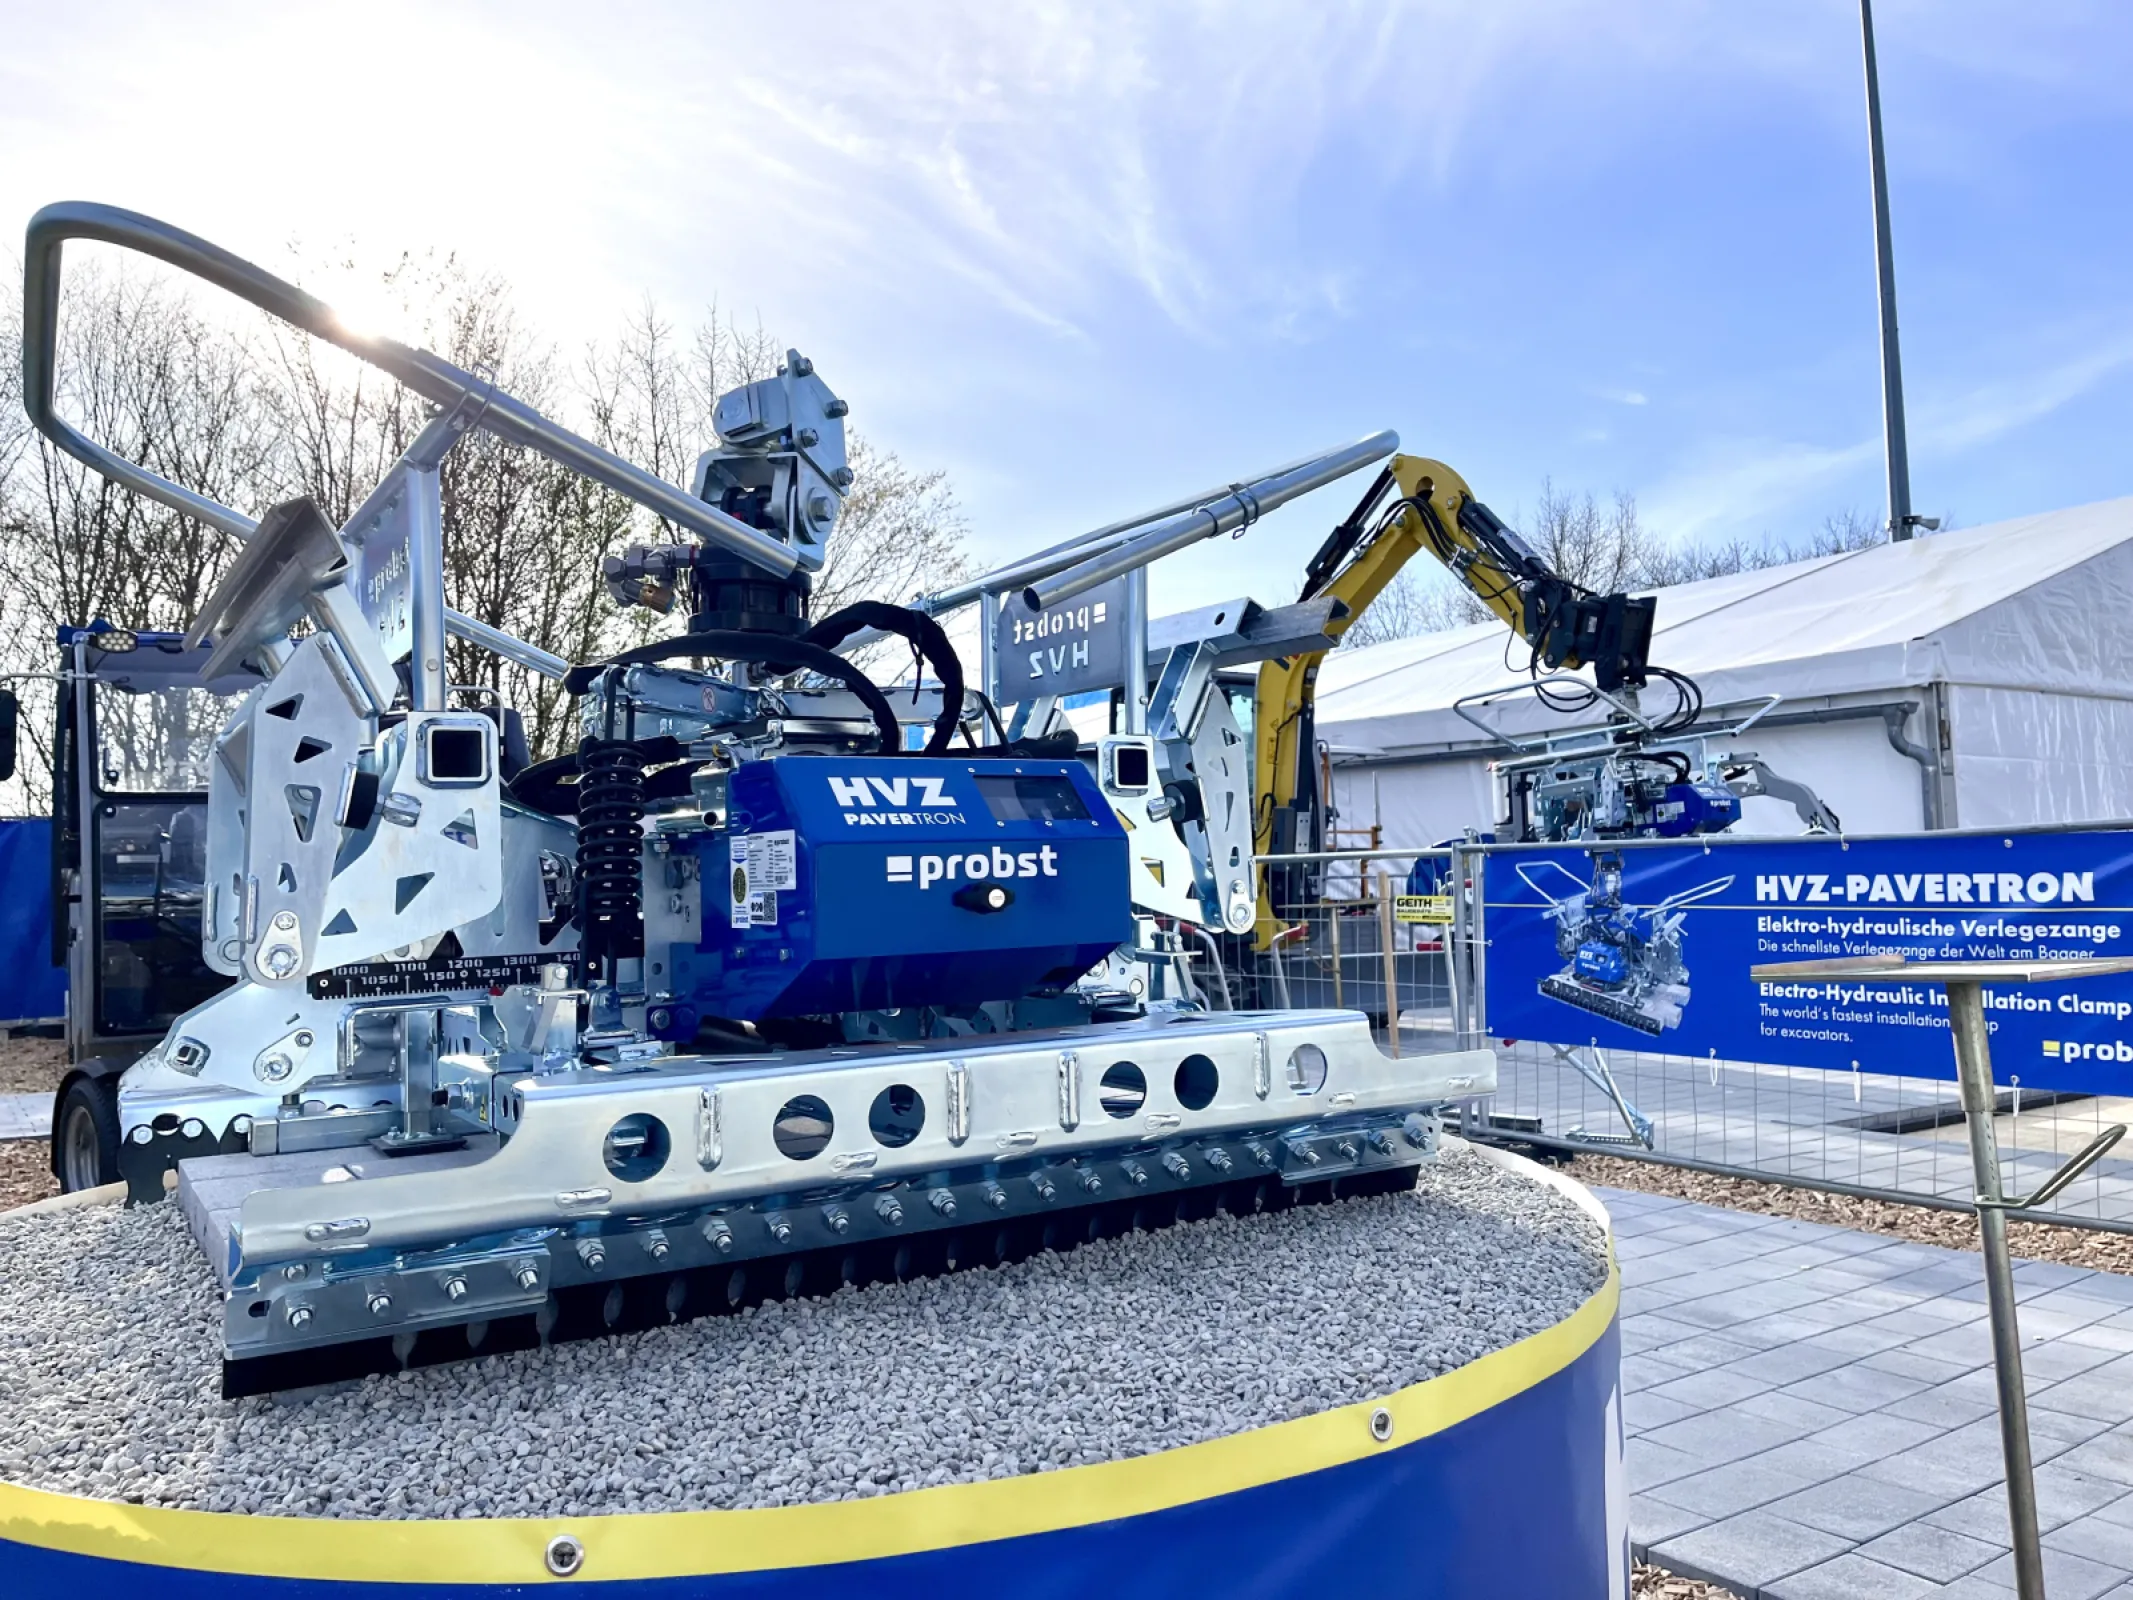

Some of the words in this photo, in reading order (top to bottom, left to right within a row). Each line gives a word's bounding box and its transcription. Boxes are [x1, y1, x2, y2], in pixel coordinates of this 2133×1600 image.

[828, 777, 957, 807] HVZ
[844, 812, 966, 826] PAVERTRON
[920, 845, 1058, 890] probst
[1756, 872, 2095, 903] HVZ-PAVERTRON
[1397, 898, 1432, 907] GEITH
[1757, 916, 1955, 940] Elektro-hydraulische
[1961, 918, 2121, 943] Verlegezange
[1758, 938, 1778, 952] Die
[1781, 939, 1841, 954] schnellste
[1940, 943, 1965, 958] der
[1968, 944, 2005, 959] Welt
[2009, 950, 2033, 959] am
[332, 966, 369, 976] 1000
[394, 962, 427, 973] 1100
[448, 959, 483, 969] 1200
[504, 955, 537, 965] 1300
[556, 952, 580, 962] 140
[361, 975, 399, 985] 1050
[423, 971, 455, 981] 1150
[476, 967, 510, 977] 1250
[1760, 982, 1925, 1006] Electro-Hydraulic
[1928, 986, 2052, 1012] Inllation
[2057, 993, 2132, 1021] Clamp
[1759, 1003, 1779, 1017] The
[1832, 1010, 1873, 1024] fastest
[1876, 1010, 1951, 1028] installation
[1760, 1022, 1778, 1037] for
[1781, 1027, 1853, 1043] excavators.
